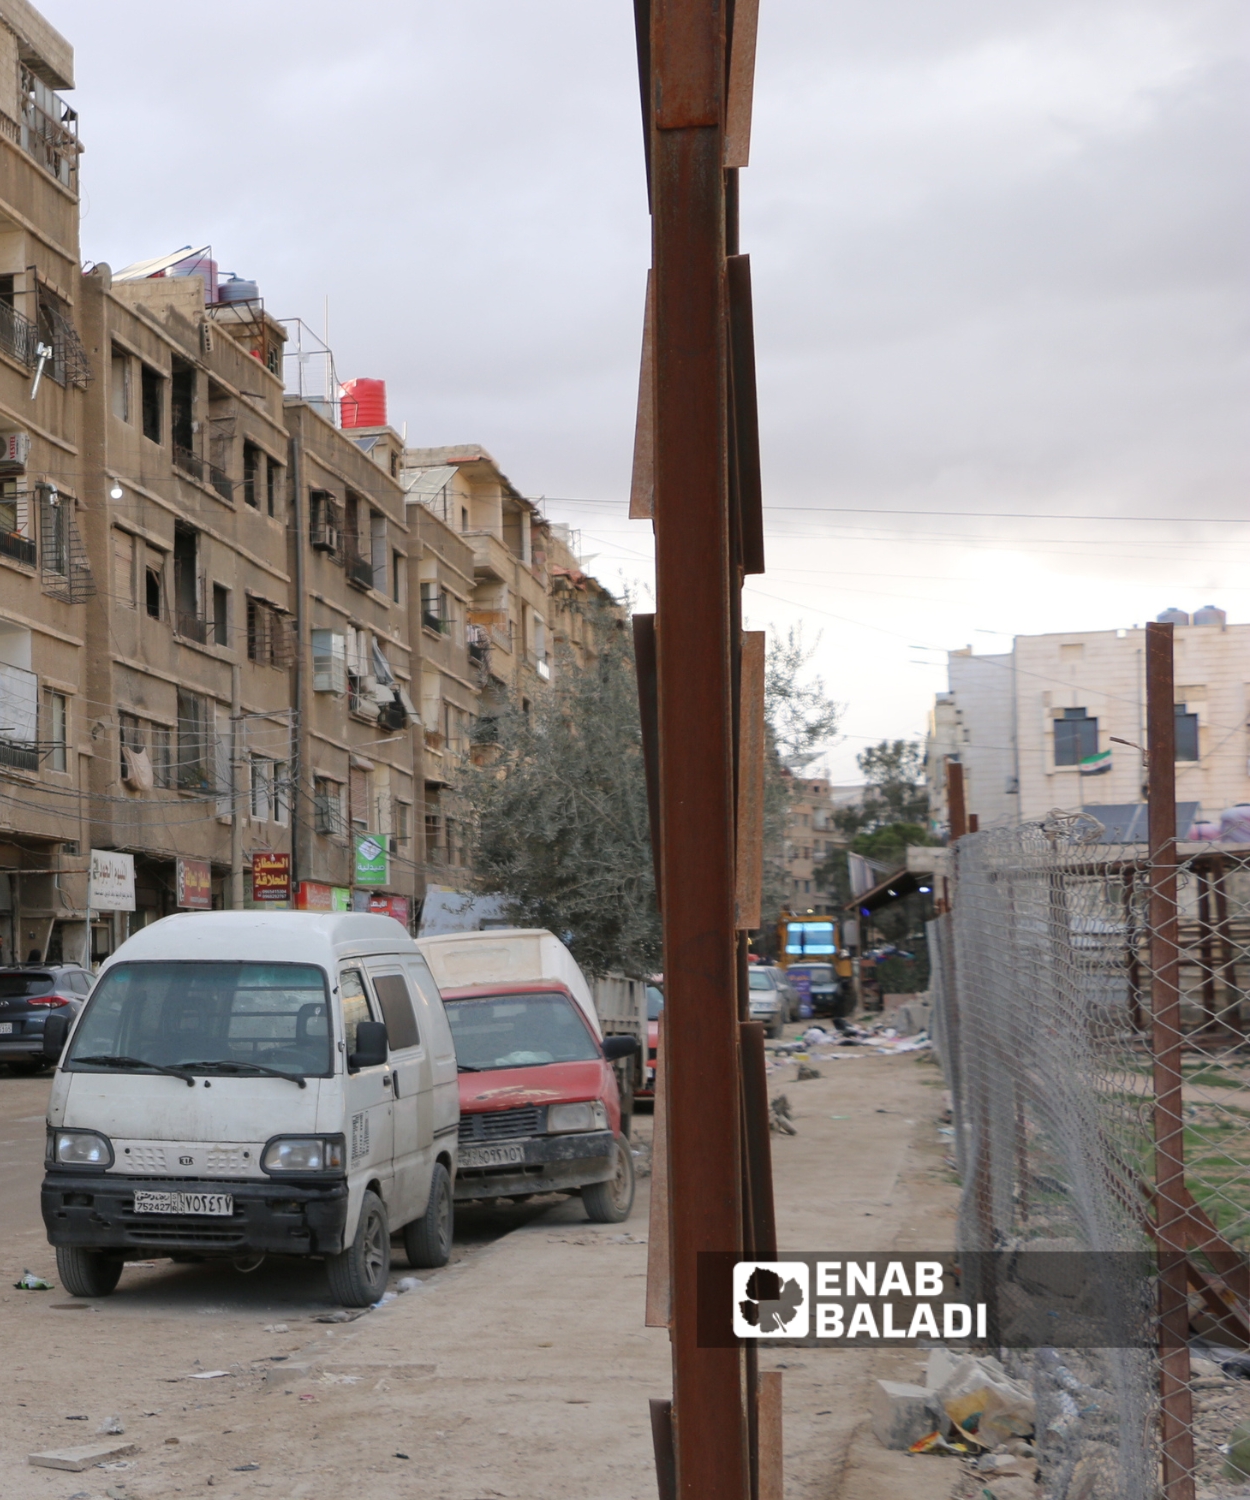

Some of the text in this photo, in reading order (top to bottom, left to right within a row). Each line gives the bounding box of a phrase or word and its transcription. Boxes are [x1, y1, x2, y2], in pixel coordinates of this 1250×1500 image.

[254, 857, 289, 872] السلطان
[357, 863, 385, 873] صيدلية
[254, 872, 289, 887] للحلاقة
[137, 1202, 171, 1212] 752427
[186, 1195, 233, 1213] ٧٥٢٤٢٧
